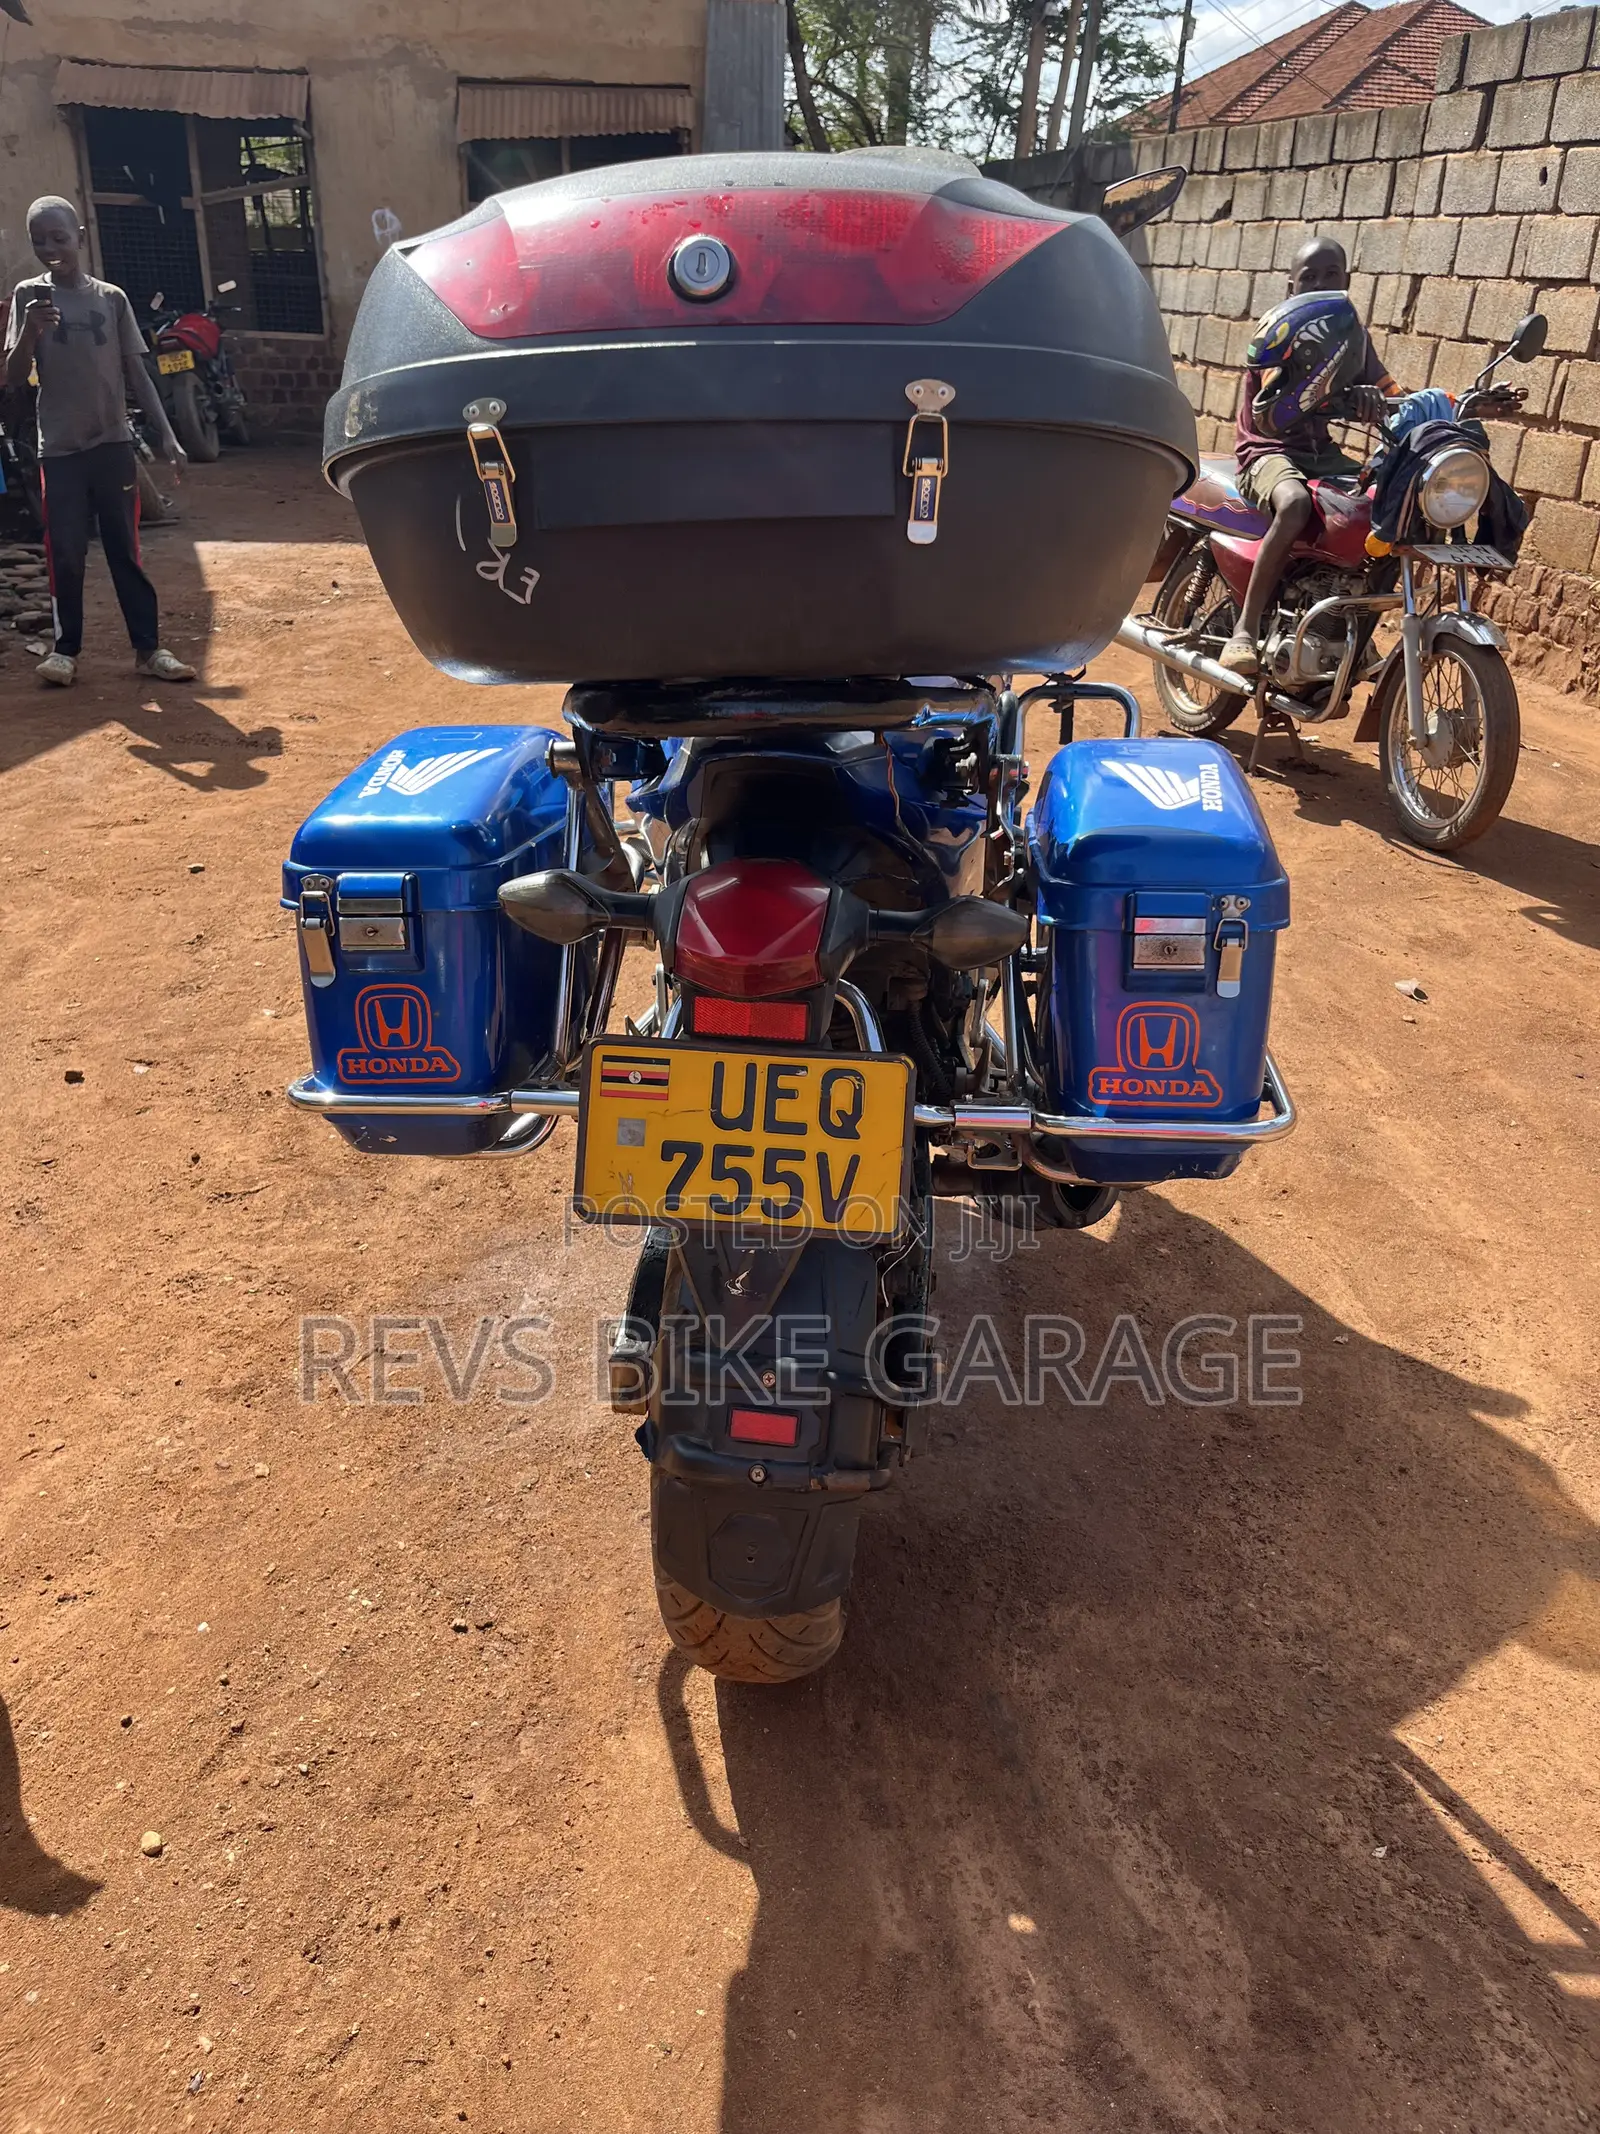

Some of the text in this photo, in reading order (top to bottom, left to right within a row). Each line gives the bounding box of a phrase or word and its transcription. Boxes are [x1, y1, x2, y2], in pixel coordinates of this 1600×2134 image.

[357, 749, 407, 799] HONDA
[1199, 763, 1224, 812] HONDA
[346, 1056, 451, 1075] HONDA
[1098, 1077, 1212, 1097] HONDA
[710, 1060, 866, 1140] UEQ
[660, 1140, 861, 1224] 755V
